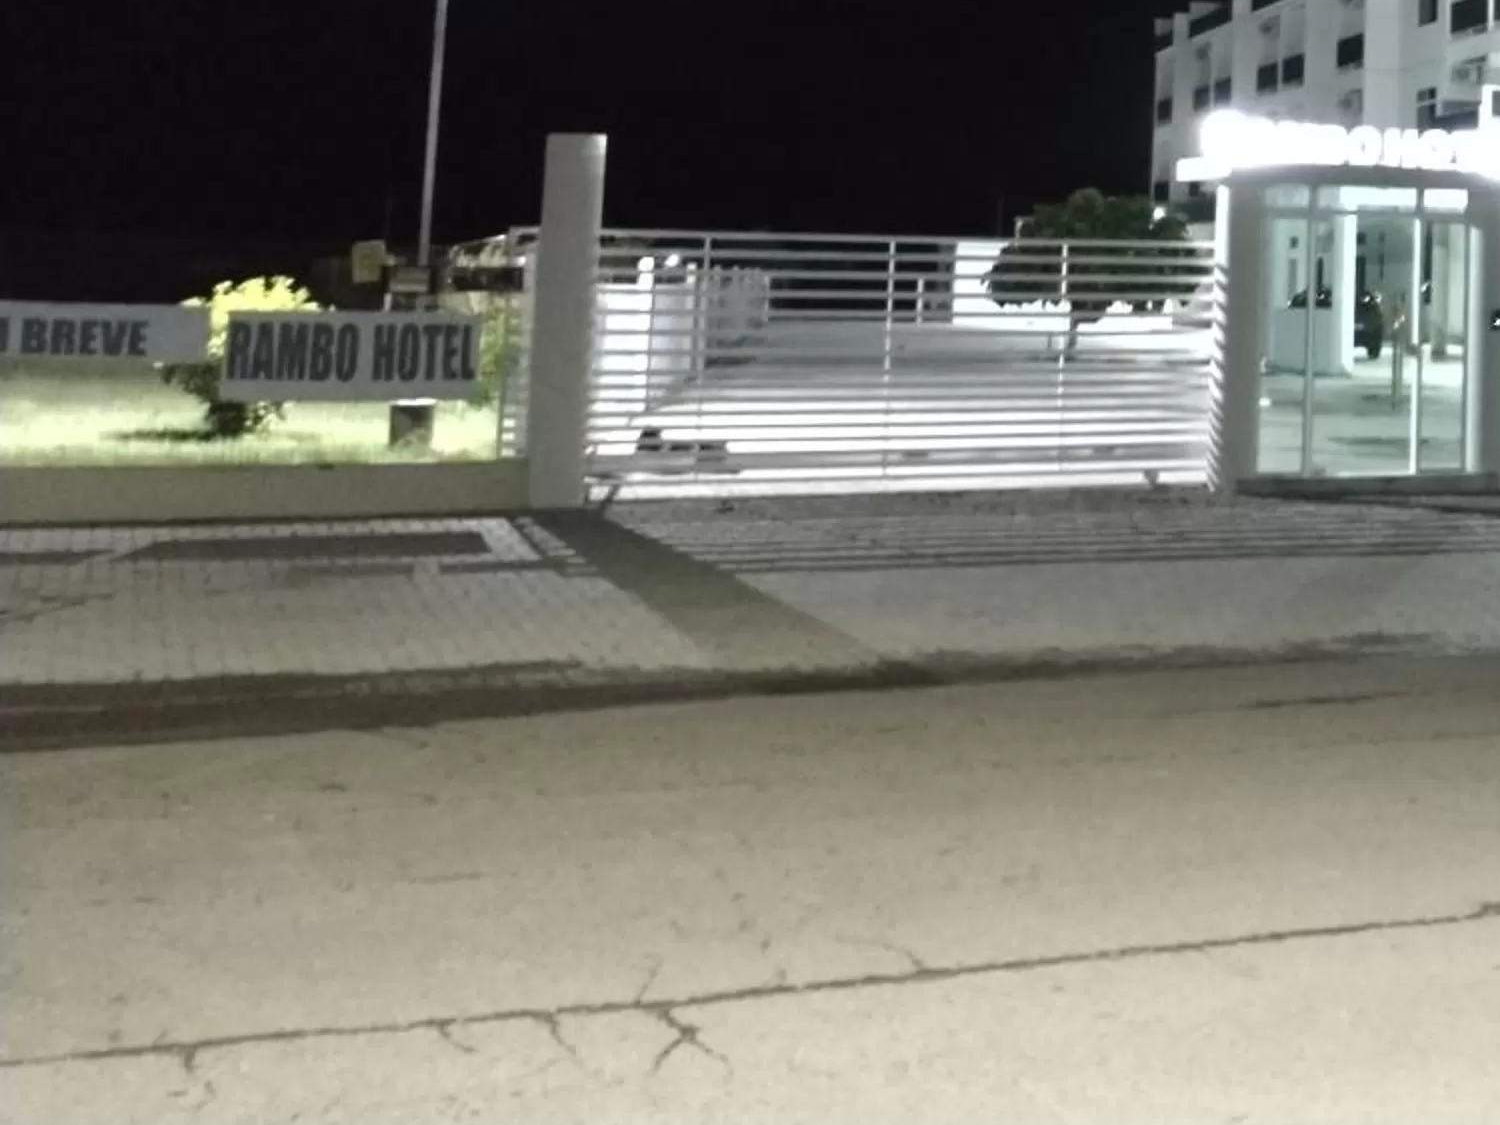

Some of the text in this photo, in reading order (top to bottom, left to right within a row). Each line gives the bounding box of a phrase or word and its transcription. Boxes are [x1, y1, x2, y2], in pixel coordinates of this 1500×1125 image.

[21, 318, 149, 356] BREVE
[226, 321, 476, 382] RAMBO HOTEL
